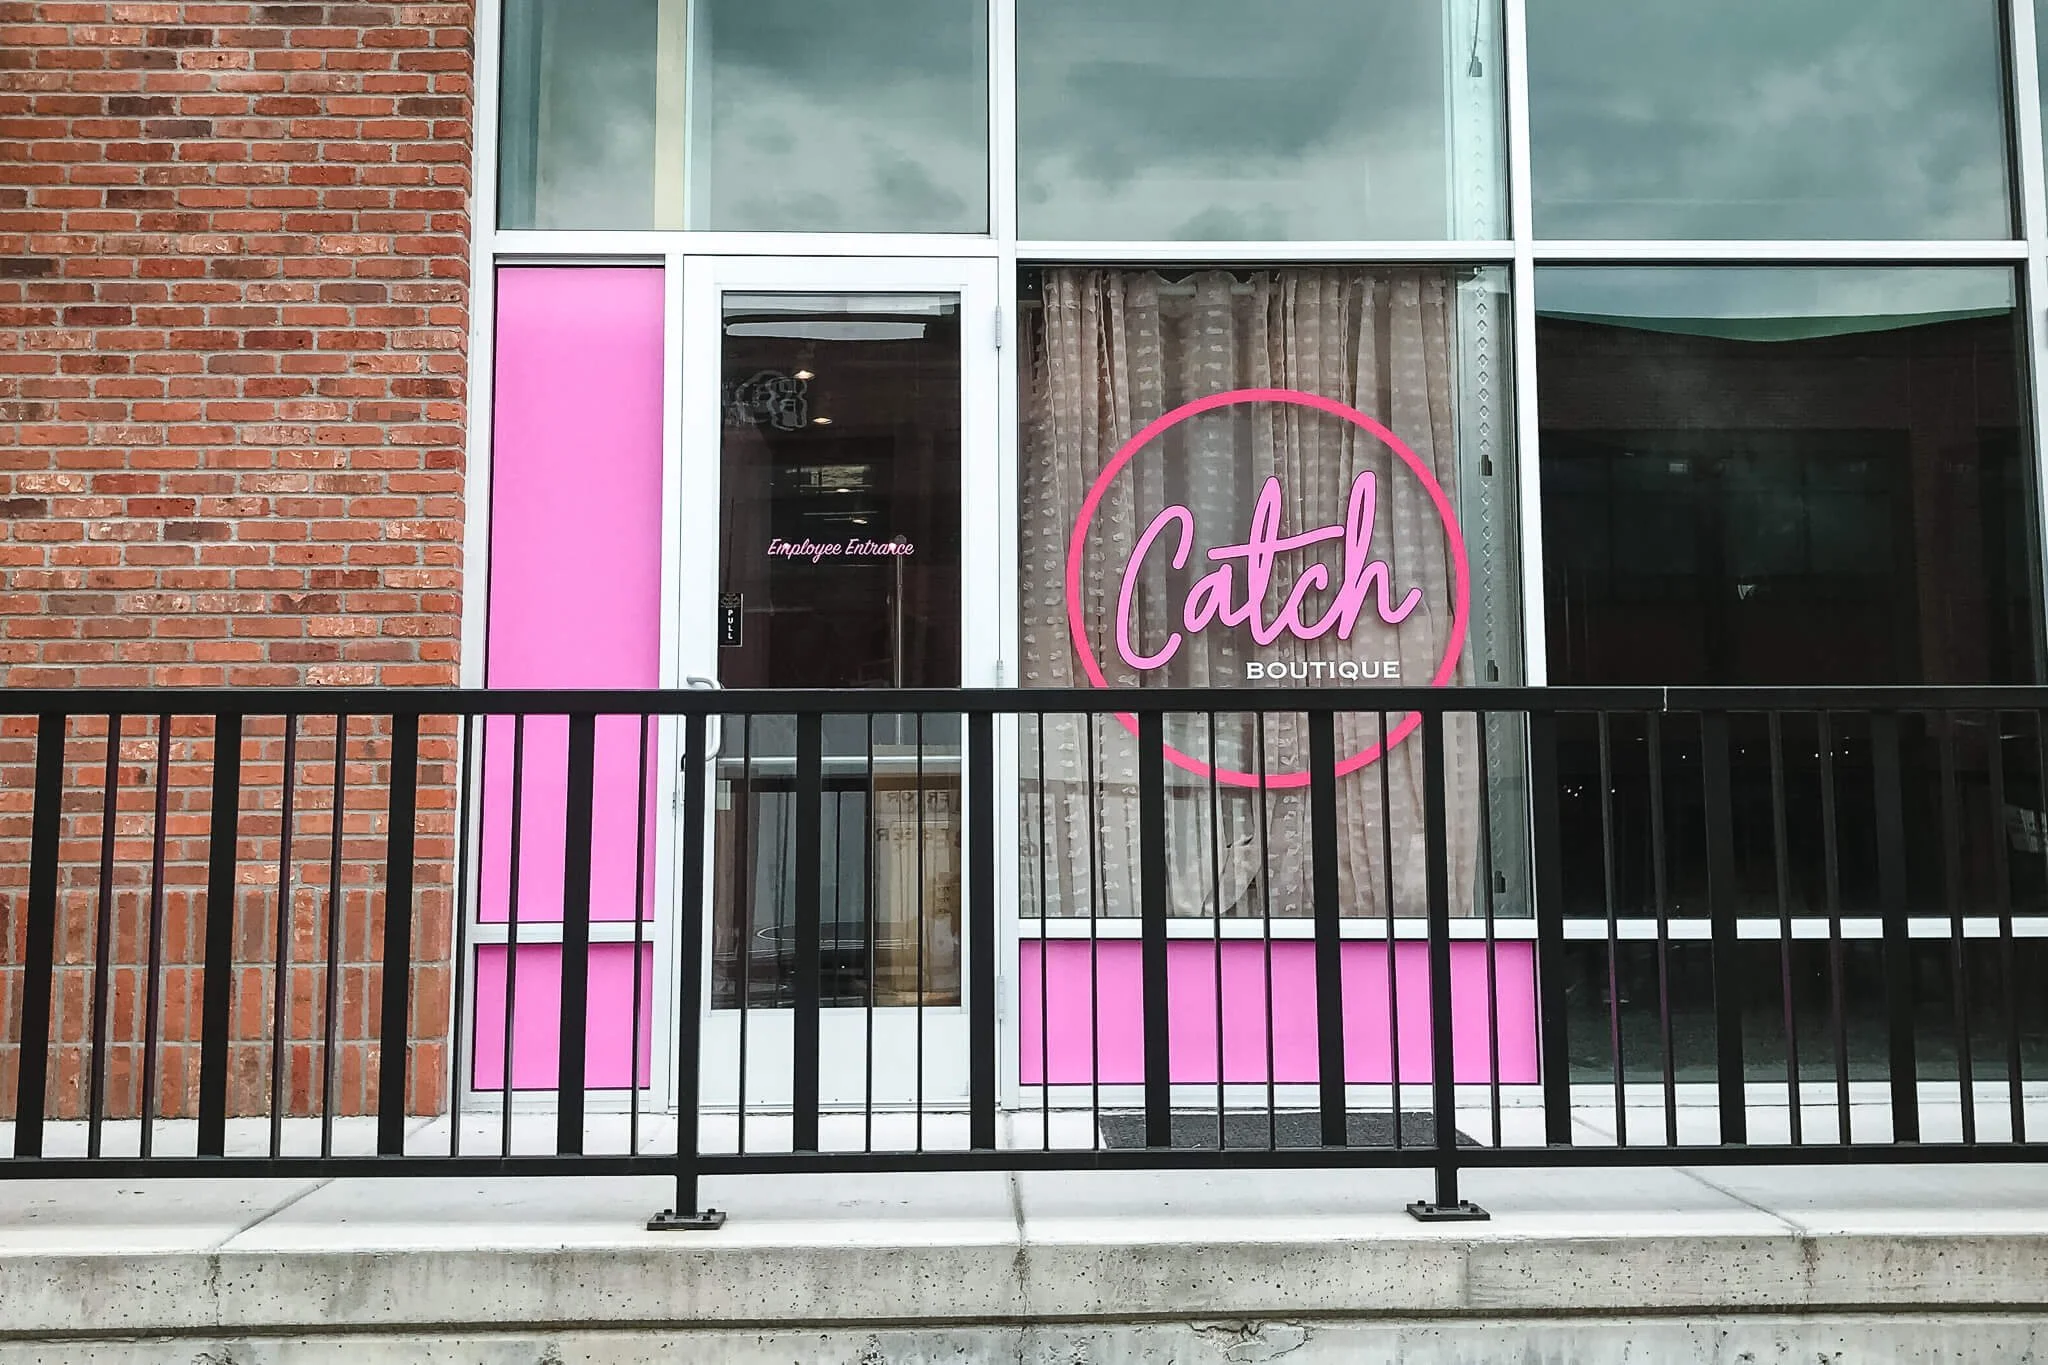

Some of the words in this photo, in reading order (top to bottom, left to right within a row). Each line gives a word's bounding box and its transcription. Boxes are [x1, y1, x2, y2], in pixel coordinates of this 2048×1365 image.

[767, 538, 843, 563] Employee
[844, 538, 915, 556] Entrance
[1116, 470, 1422, 670] Catch
[1246, 661, 1401, 680] BOUTIQUE
